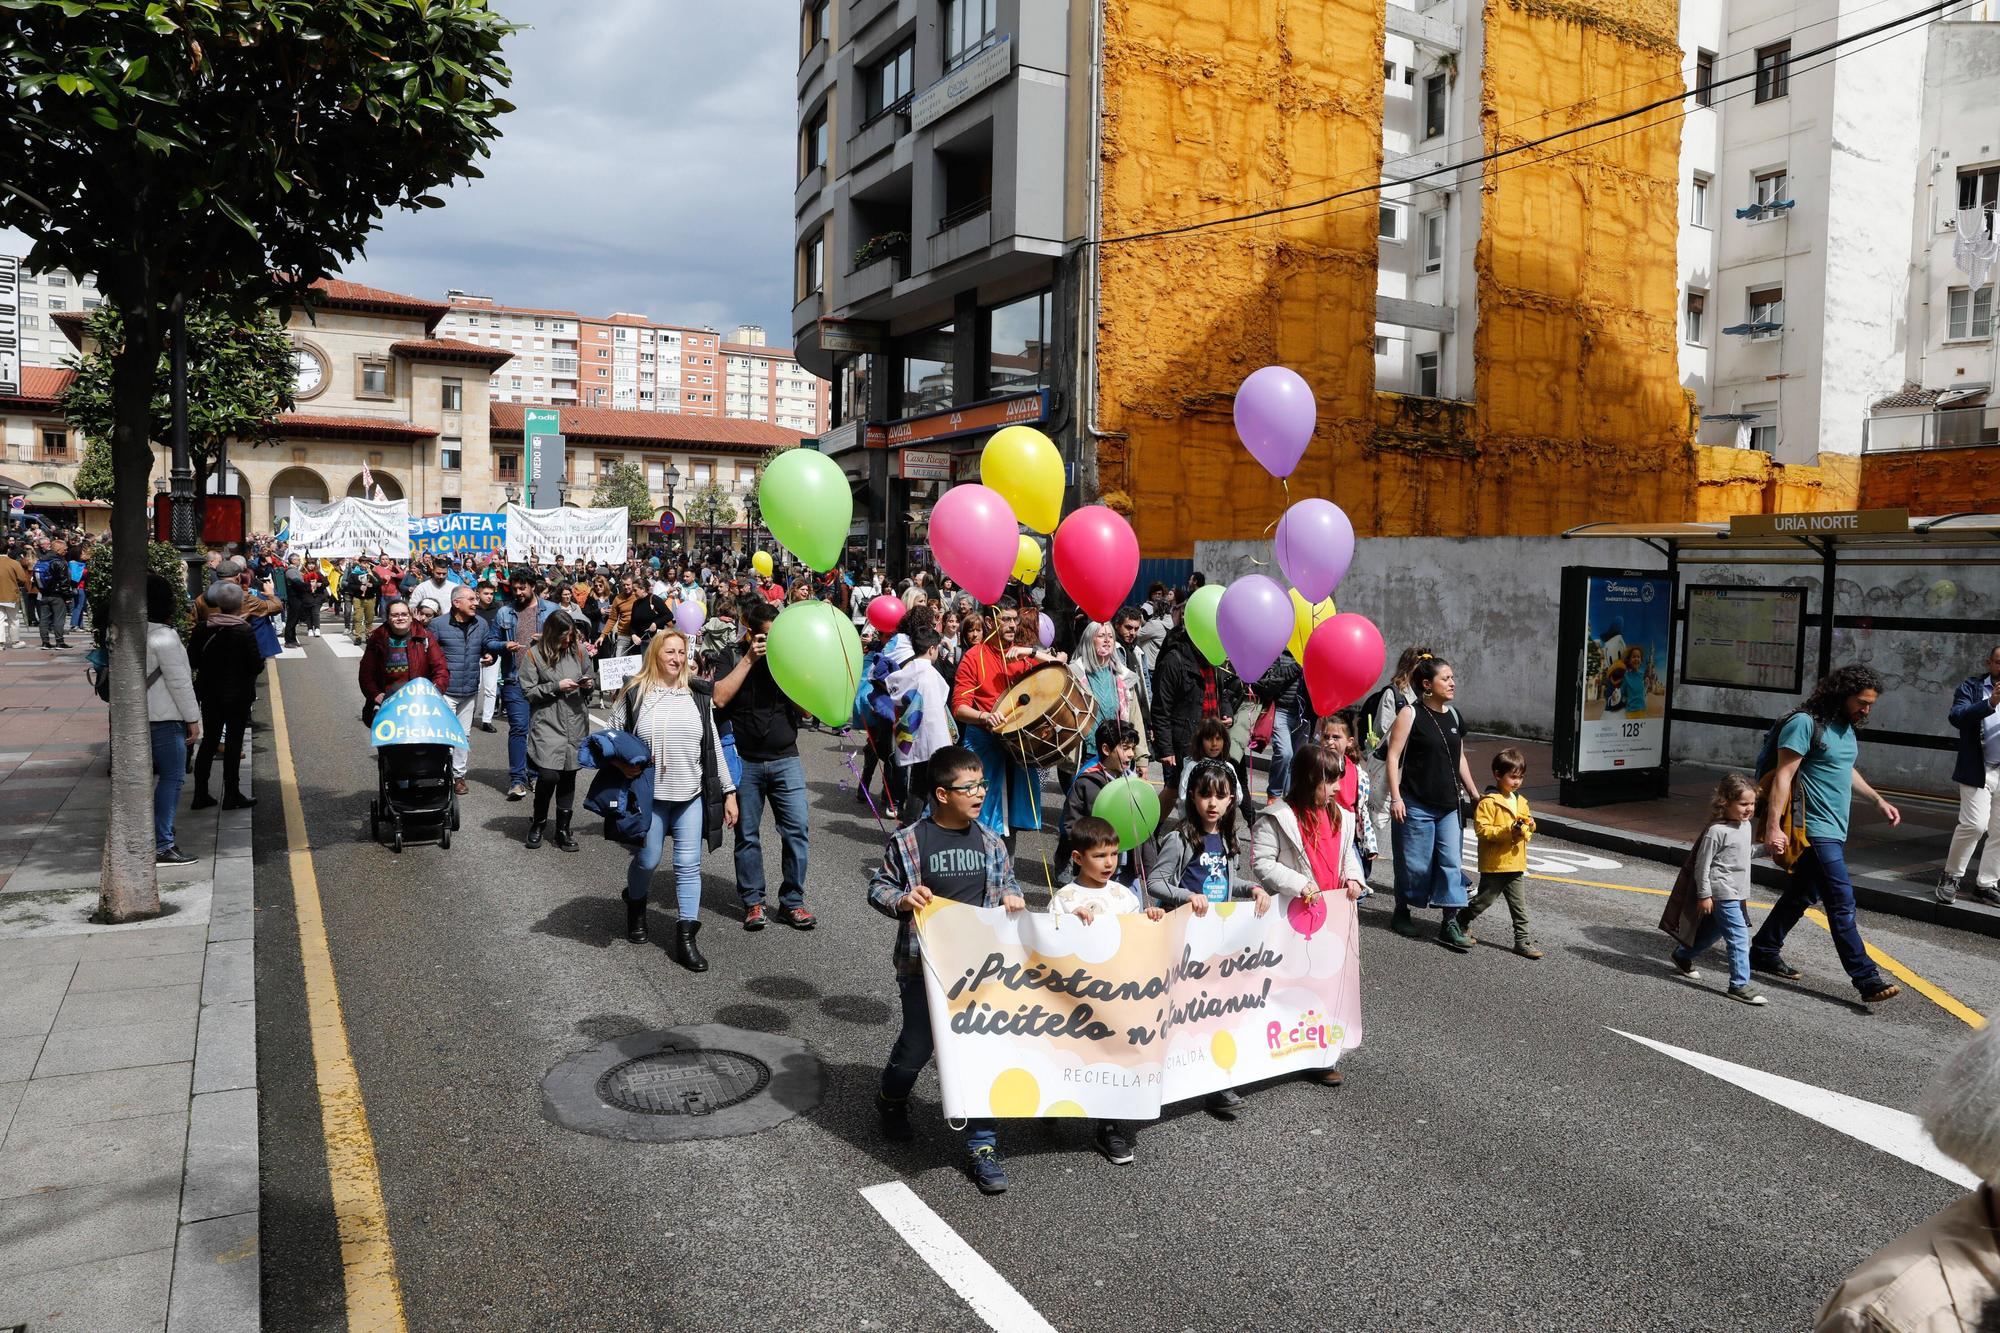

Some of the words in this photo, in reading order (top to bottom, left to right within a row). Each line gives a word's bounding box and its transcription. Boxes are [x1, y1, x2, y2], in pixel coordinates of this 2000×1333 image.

[533, 451, 542, 479] OVIEDO
[906, 452, 925, 464] Casa
[911, 468, 943, 478] MUEBLES
[427, 515, 494, 534] SUATEA
[1774, 514, 1807, 531] URÍA
[1810, 514, 1859, 530] NORTE
[409, 534, 503, 553] OFICIALID
[396, 702, 442, 717] POLA
[929, 848, 987, 873] DETROIT
[1219, 941, 1284, 978] vida
[950, 999, 1116, 1040] dicítelo
[1063, 1067, 1141, 1088] RECIELLA
